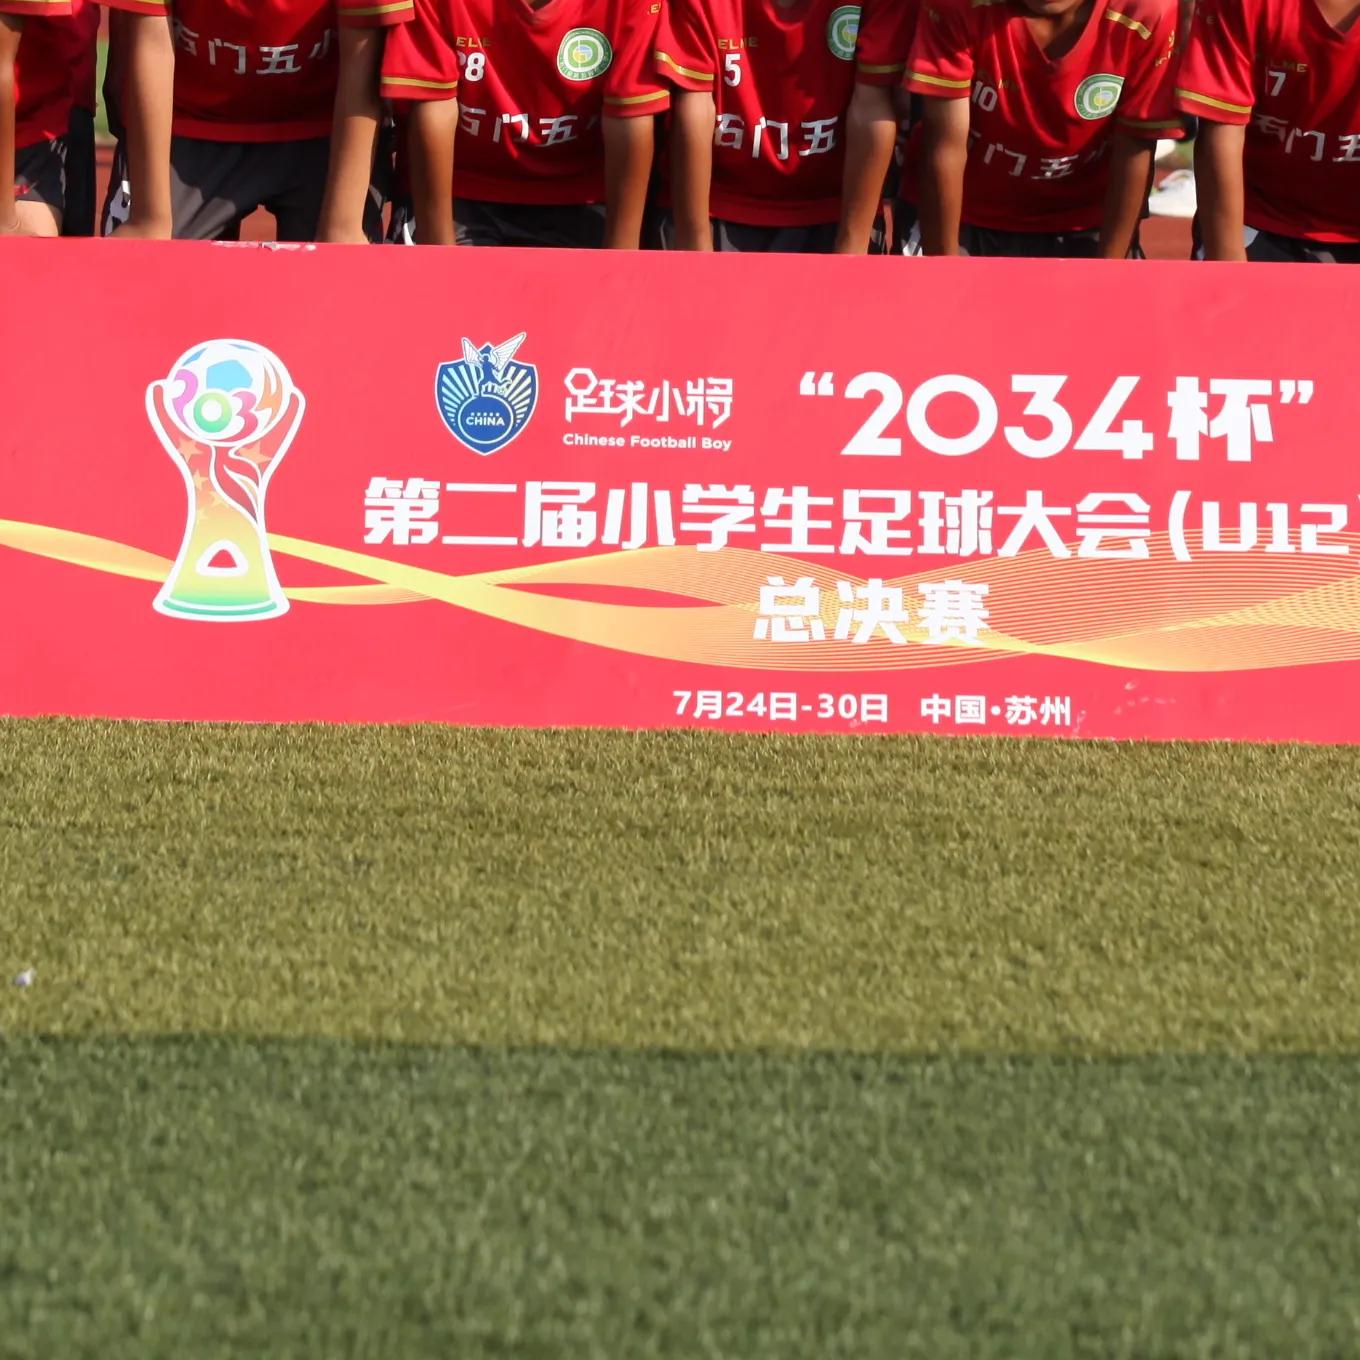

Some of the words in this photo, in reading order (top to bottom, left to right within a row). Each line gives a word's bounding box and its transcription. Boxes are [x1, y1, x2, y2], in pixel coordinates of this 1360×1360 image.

[723, 52, 741, 88] 5
[971, 80, 998, 113] 10
[464, 415, 506, 427] CHINA
[562, 432, 626, 448] Chinese
[630, 434, 697, 450] Football
[701, 436, 733, 452] Boy
[752, 576, 991, 645] 总决赛
[671, 690, 889, 723] 7月24日-30日
[919, 694, 1072, 727] 中国·苏州
